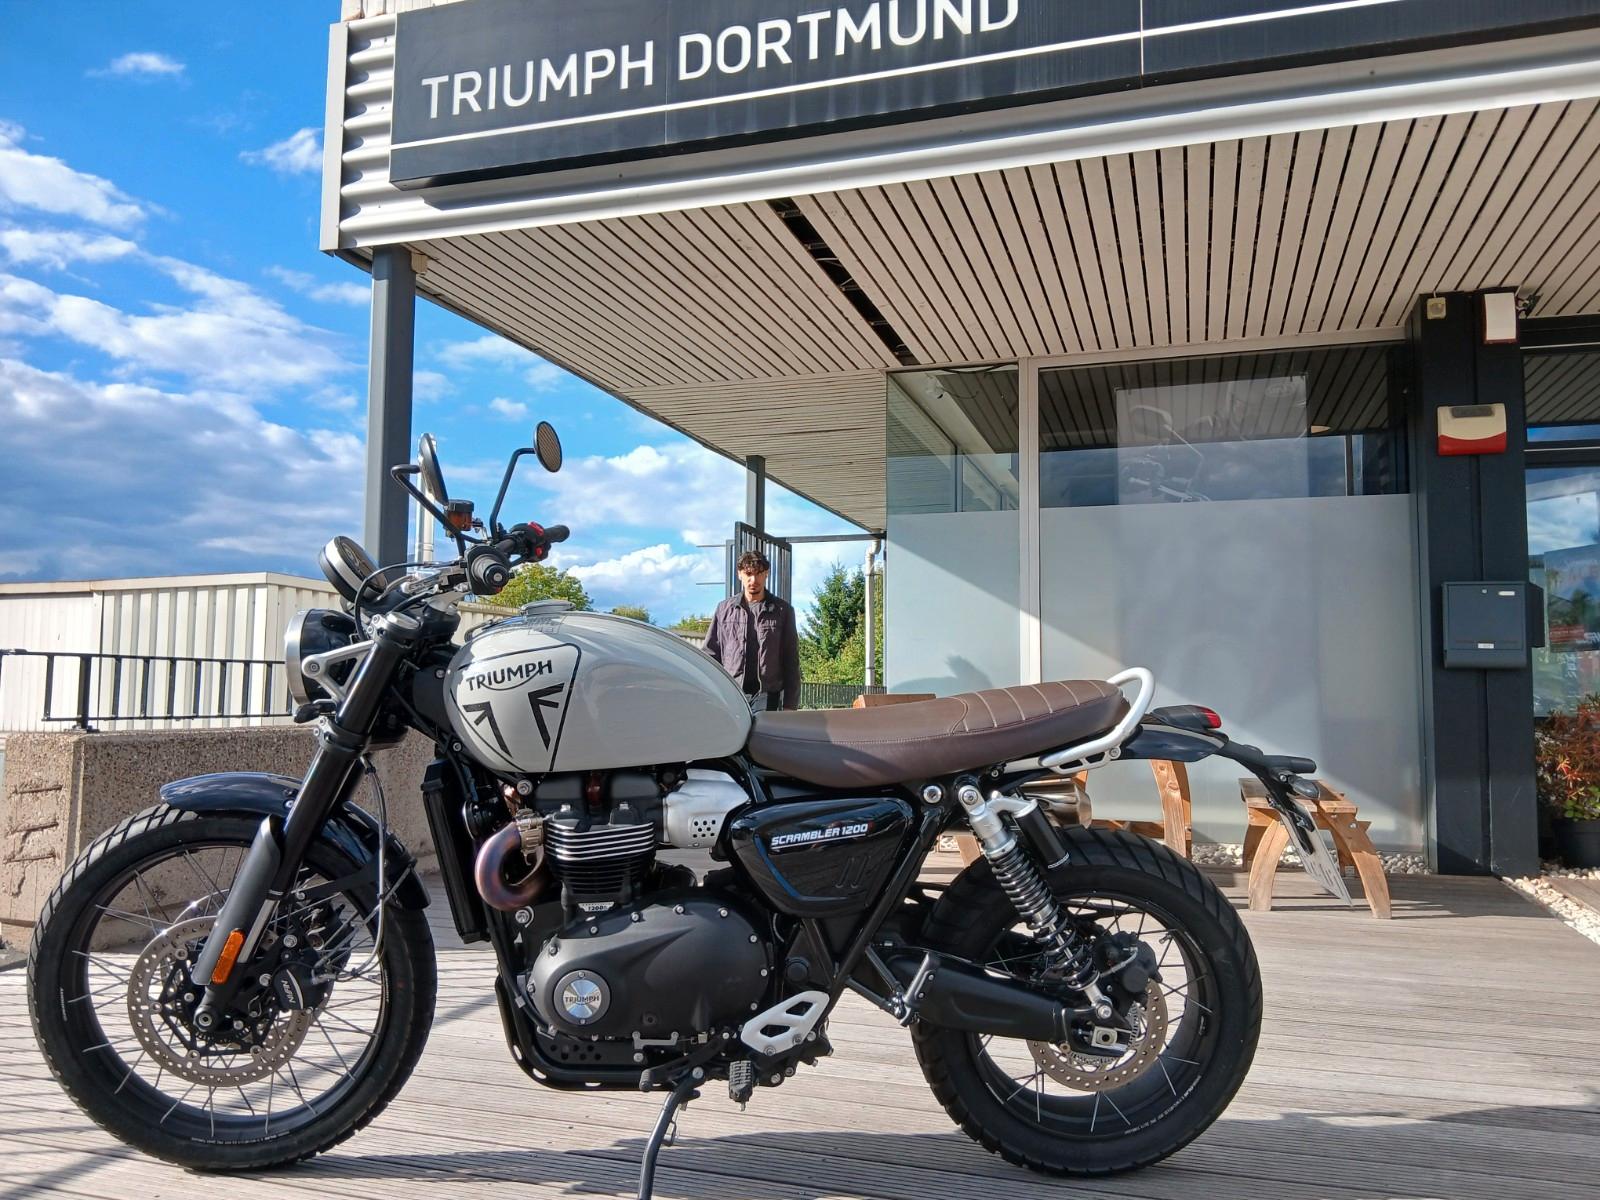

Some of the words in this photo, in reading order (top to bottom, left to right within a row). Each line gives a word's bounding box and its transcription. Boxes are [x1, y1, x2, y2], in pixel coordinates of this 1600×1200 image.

[422, 41, 654, 118] TRIUMPH
[679, 0, 1019, 80] DORTMUND
[466, 660, 552, 691] TRIUMPH
[771, 828, 840, 846] SCRAMBLER
[841, 823, 868, 835] 1200
[565, 995, 600, 1003] TRIUMPH
